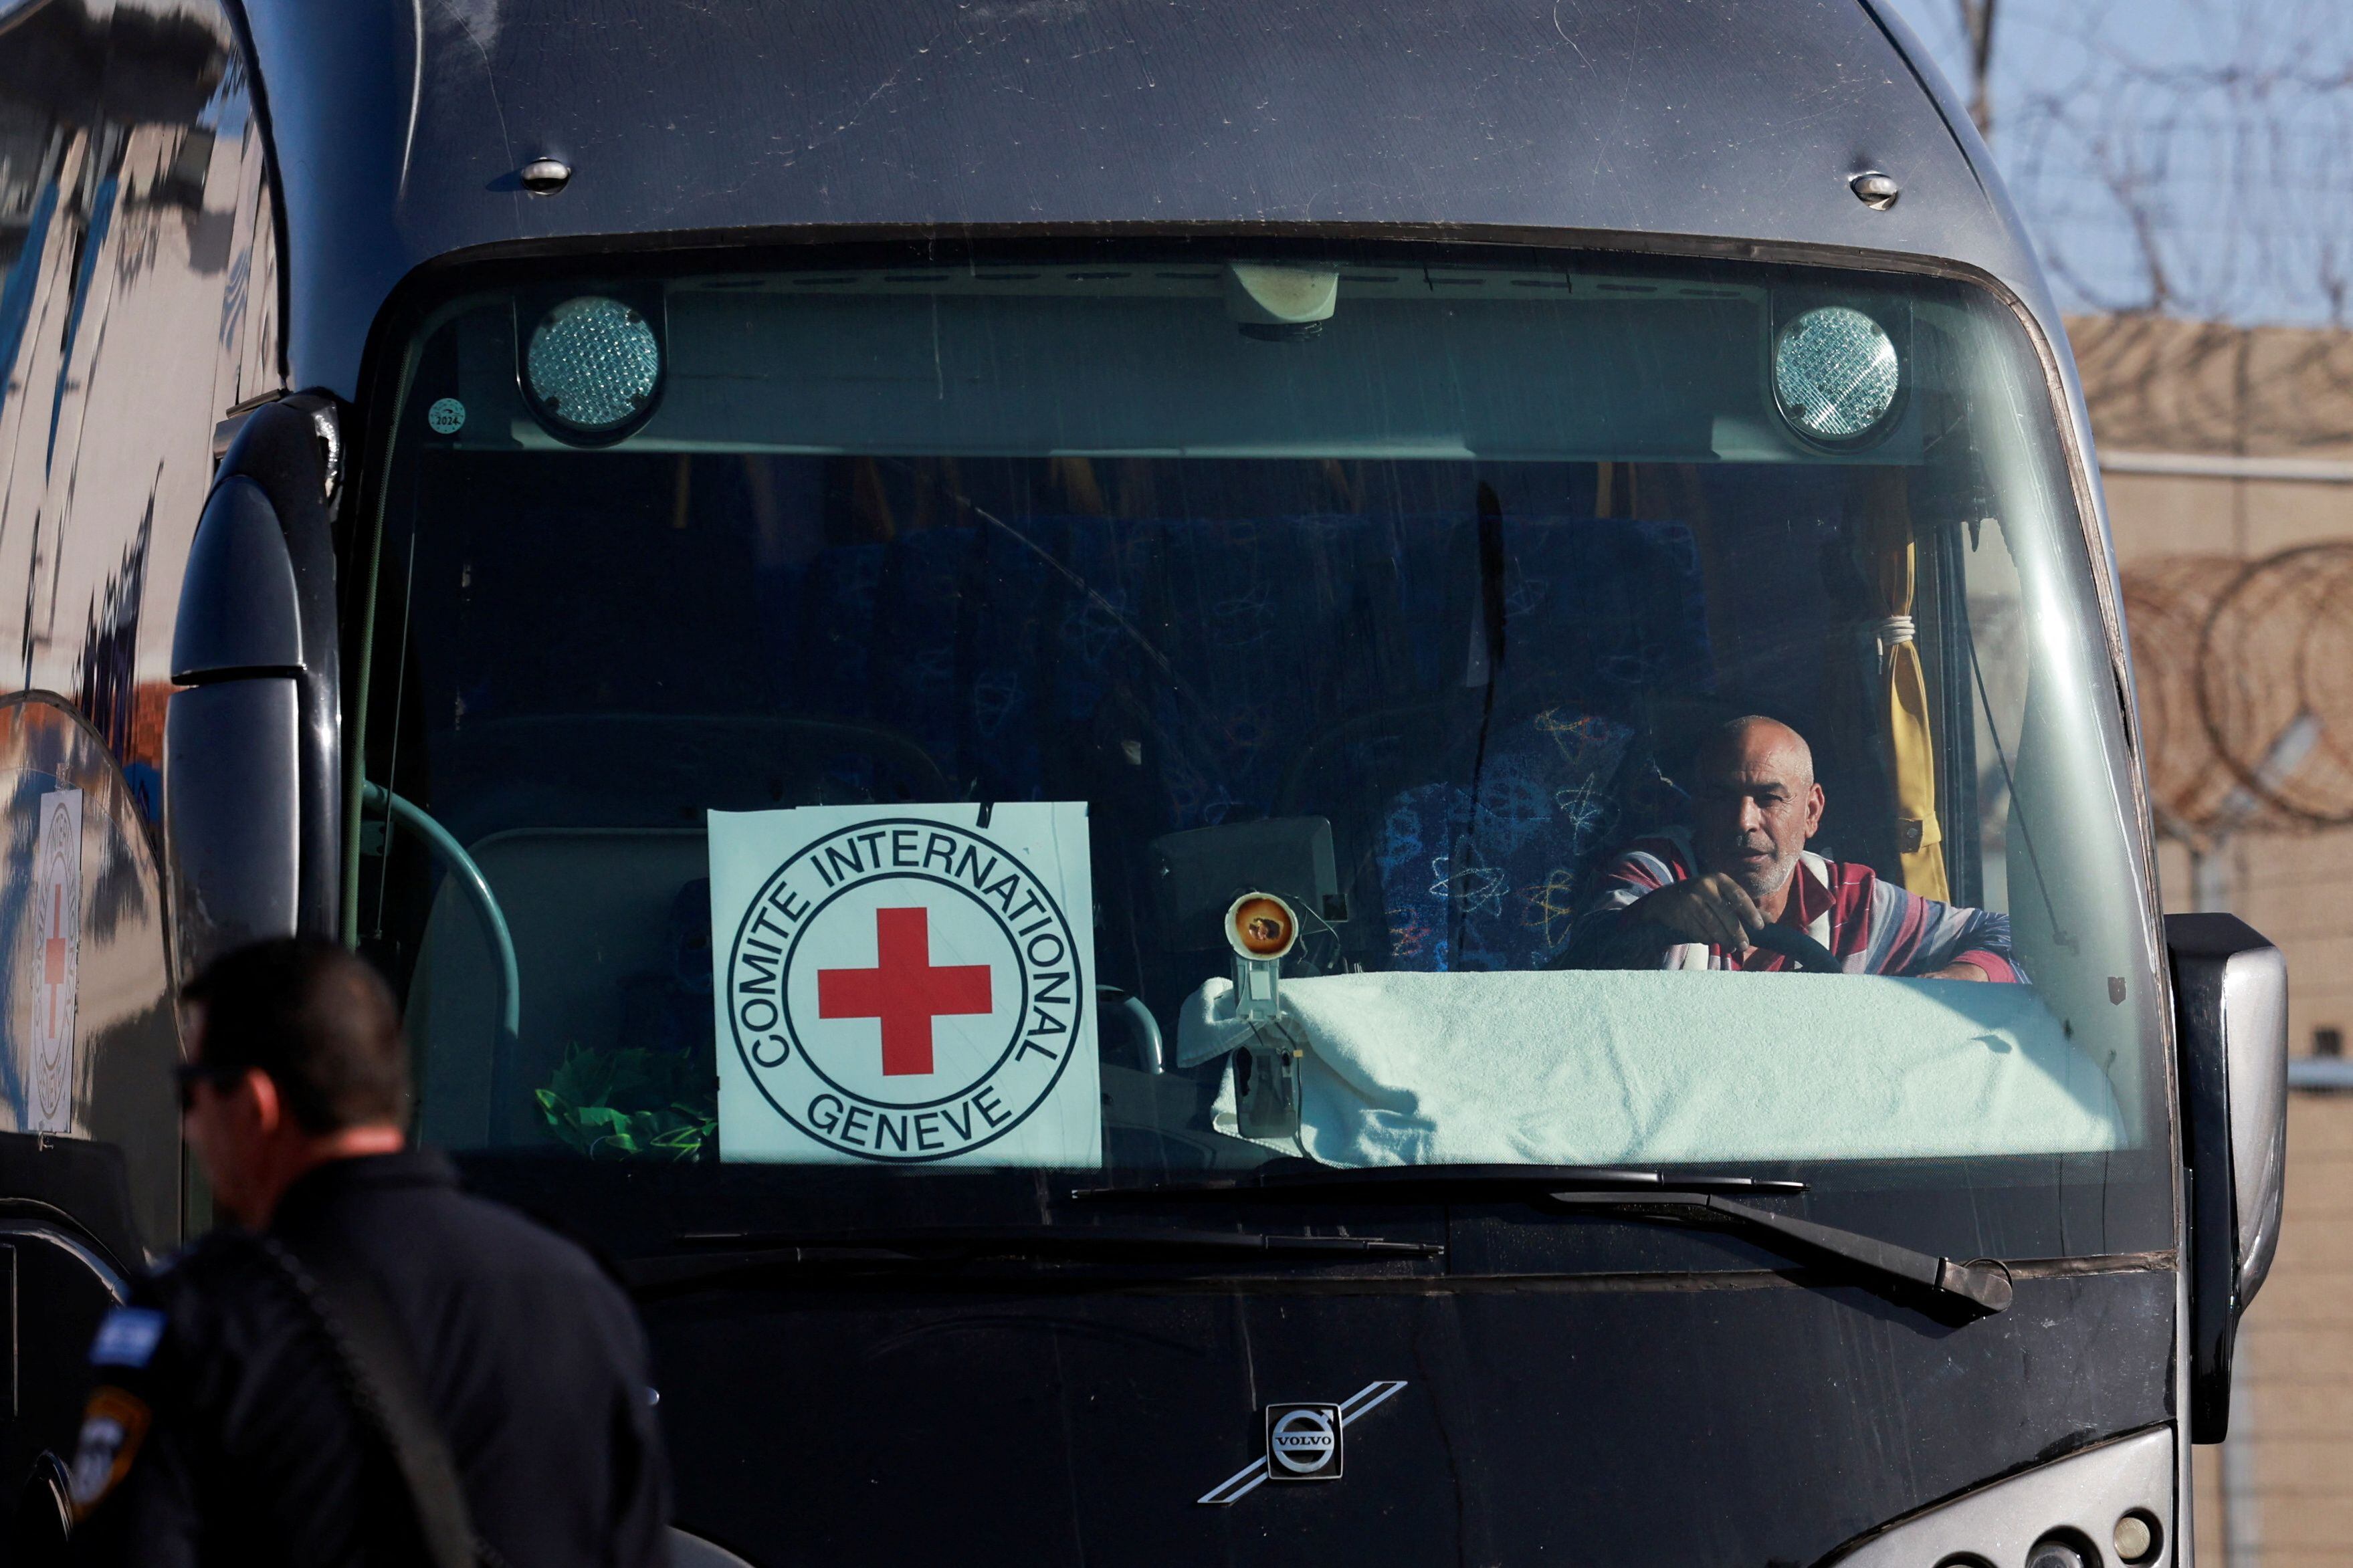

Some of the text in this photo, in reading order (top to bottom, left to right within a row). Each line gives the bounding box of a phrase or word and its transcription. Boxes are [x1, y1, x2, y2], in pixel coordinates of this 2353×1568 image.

[435, 416, 461, 426] 2024
[739, 830, 1071, 1068] COMITE INTERNATIONAL
[807, 1086, 1013, 1151] GENEVE
[1275, 1436, 1332, 1446] VOLVO
